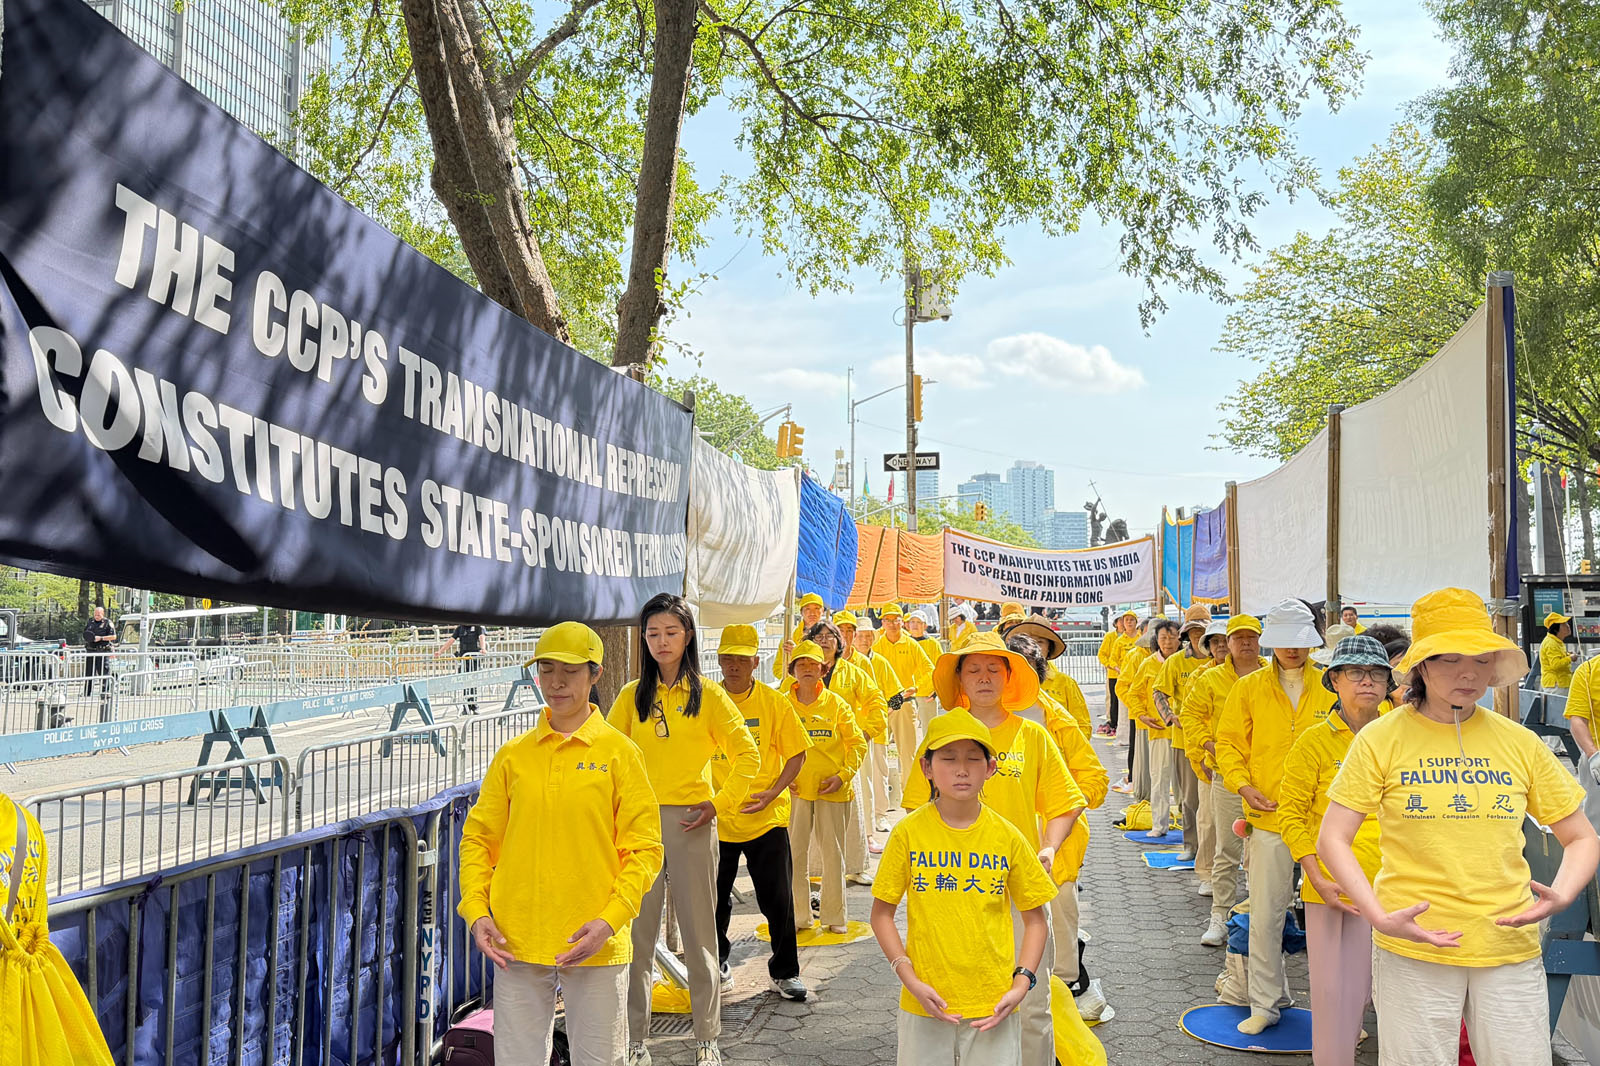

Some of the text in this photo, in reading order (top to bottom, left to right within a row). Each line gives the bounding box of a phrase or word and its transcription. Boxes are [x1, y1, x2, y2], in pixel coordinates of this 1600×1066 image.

[114, 183, 235, 335] THE
[399, 346, 603, 489] TRANSNATIONAL
[606, 443, 682, 503] REPRESSION
[29, 325, 408, 540] CONSTITUTES
[420, 478, 633, 578] STATE-SPONSORED
[892, 457, 933, 467] ONE WAY
[950, 542, 1140, 572] THE CCP MANIPULATES THE US MEDIA
[961, 560, 1133, 588] TO SPREAD DISINFORMATION AND
[1000, 583, 1103, 604] SMEAR FALUN GONG
[302, 698, 321, 711] POLICE
[43, 730, 73, 745] POLICE
[80, 726, 98, 740] LINE
[109, 724, 120, 736] DO
[122, 721, 138, 735] NOT
[140, 719, 164, 732] CROSS
[93, 736, 120, 748] NYPD
[1419, 757, 1491, 768] I SUPPORT
[1400, 769, 1513, 786] FALUN GONG
[1447, 793, 1473, 813] 善
[1492, 794, 1515, 814] 忍
[909, 850, 1010, 871] FALUN DAFA
[911, 872, 1006, 895] 法輪大法
[419, 927, 433, 1019] NYPD
